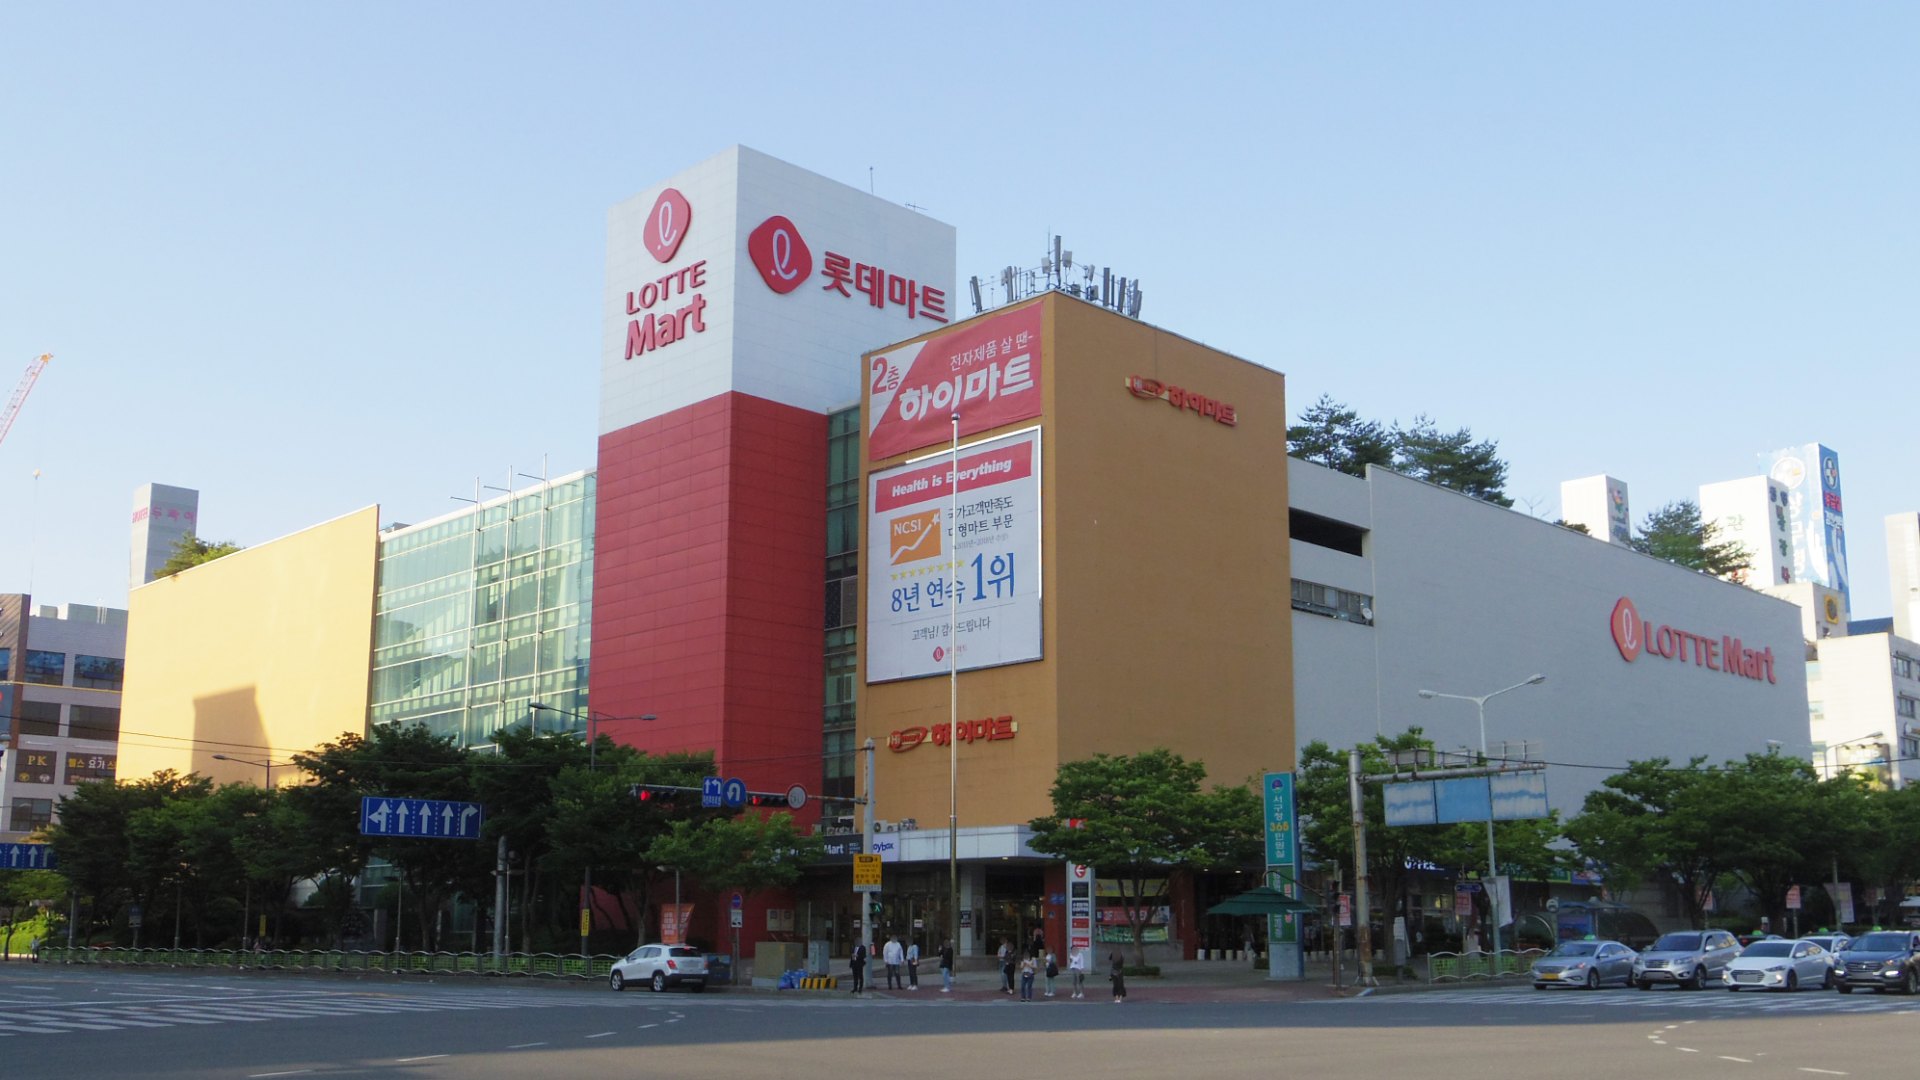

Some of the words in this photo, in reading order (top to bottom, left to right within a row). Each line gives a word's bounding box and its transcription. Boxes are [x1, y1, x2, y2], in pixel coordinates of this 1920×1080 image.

[625, 259, 707, 315] LOTTE
[821, 250, 949, 324] 롯데마트
[624, 294, 707, 360] Mart
[950, 339, 998, 372] 전자제품
[1000, 335, 1013, 356] 살
[872, 356, 900, 395] 2층
[899, 352, 1034, 421] 하이마트
[1168, 385, 1237, 428] 하이마트
[891, 478, 929, 498] Health
[932, 474, 943, 488] is
[893, 521, 922, 536] NCSI
[992, 514, 1014, 532] 부문
[891, 583, 920, 613] 8년
[926, 576, 966, 608] 연속
[971, 552, 1015, 601] 1위
[941, 615, 992, 637] 감드립니다
[1644, 621, 1720, 671] LOTTE
[1723, 635, 1776, 685] Mart
[931, 715, 1015, 746] 하이마트
[872, 842, 895, 853] oybox
